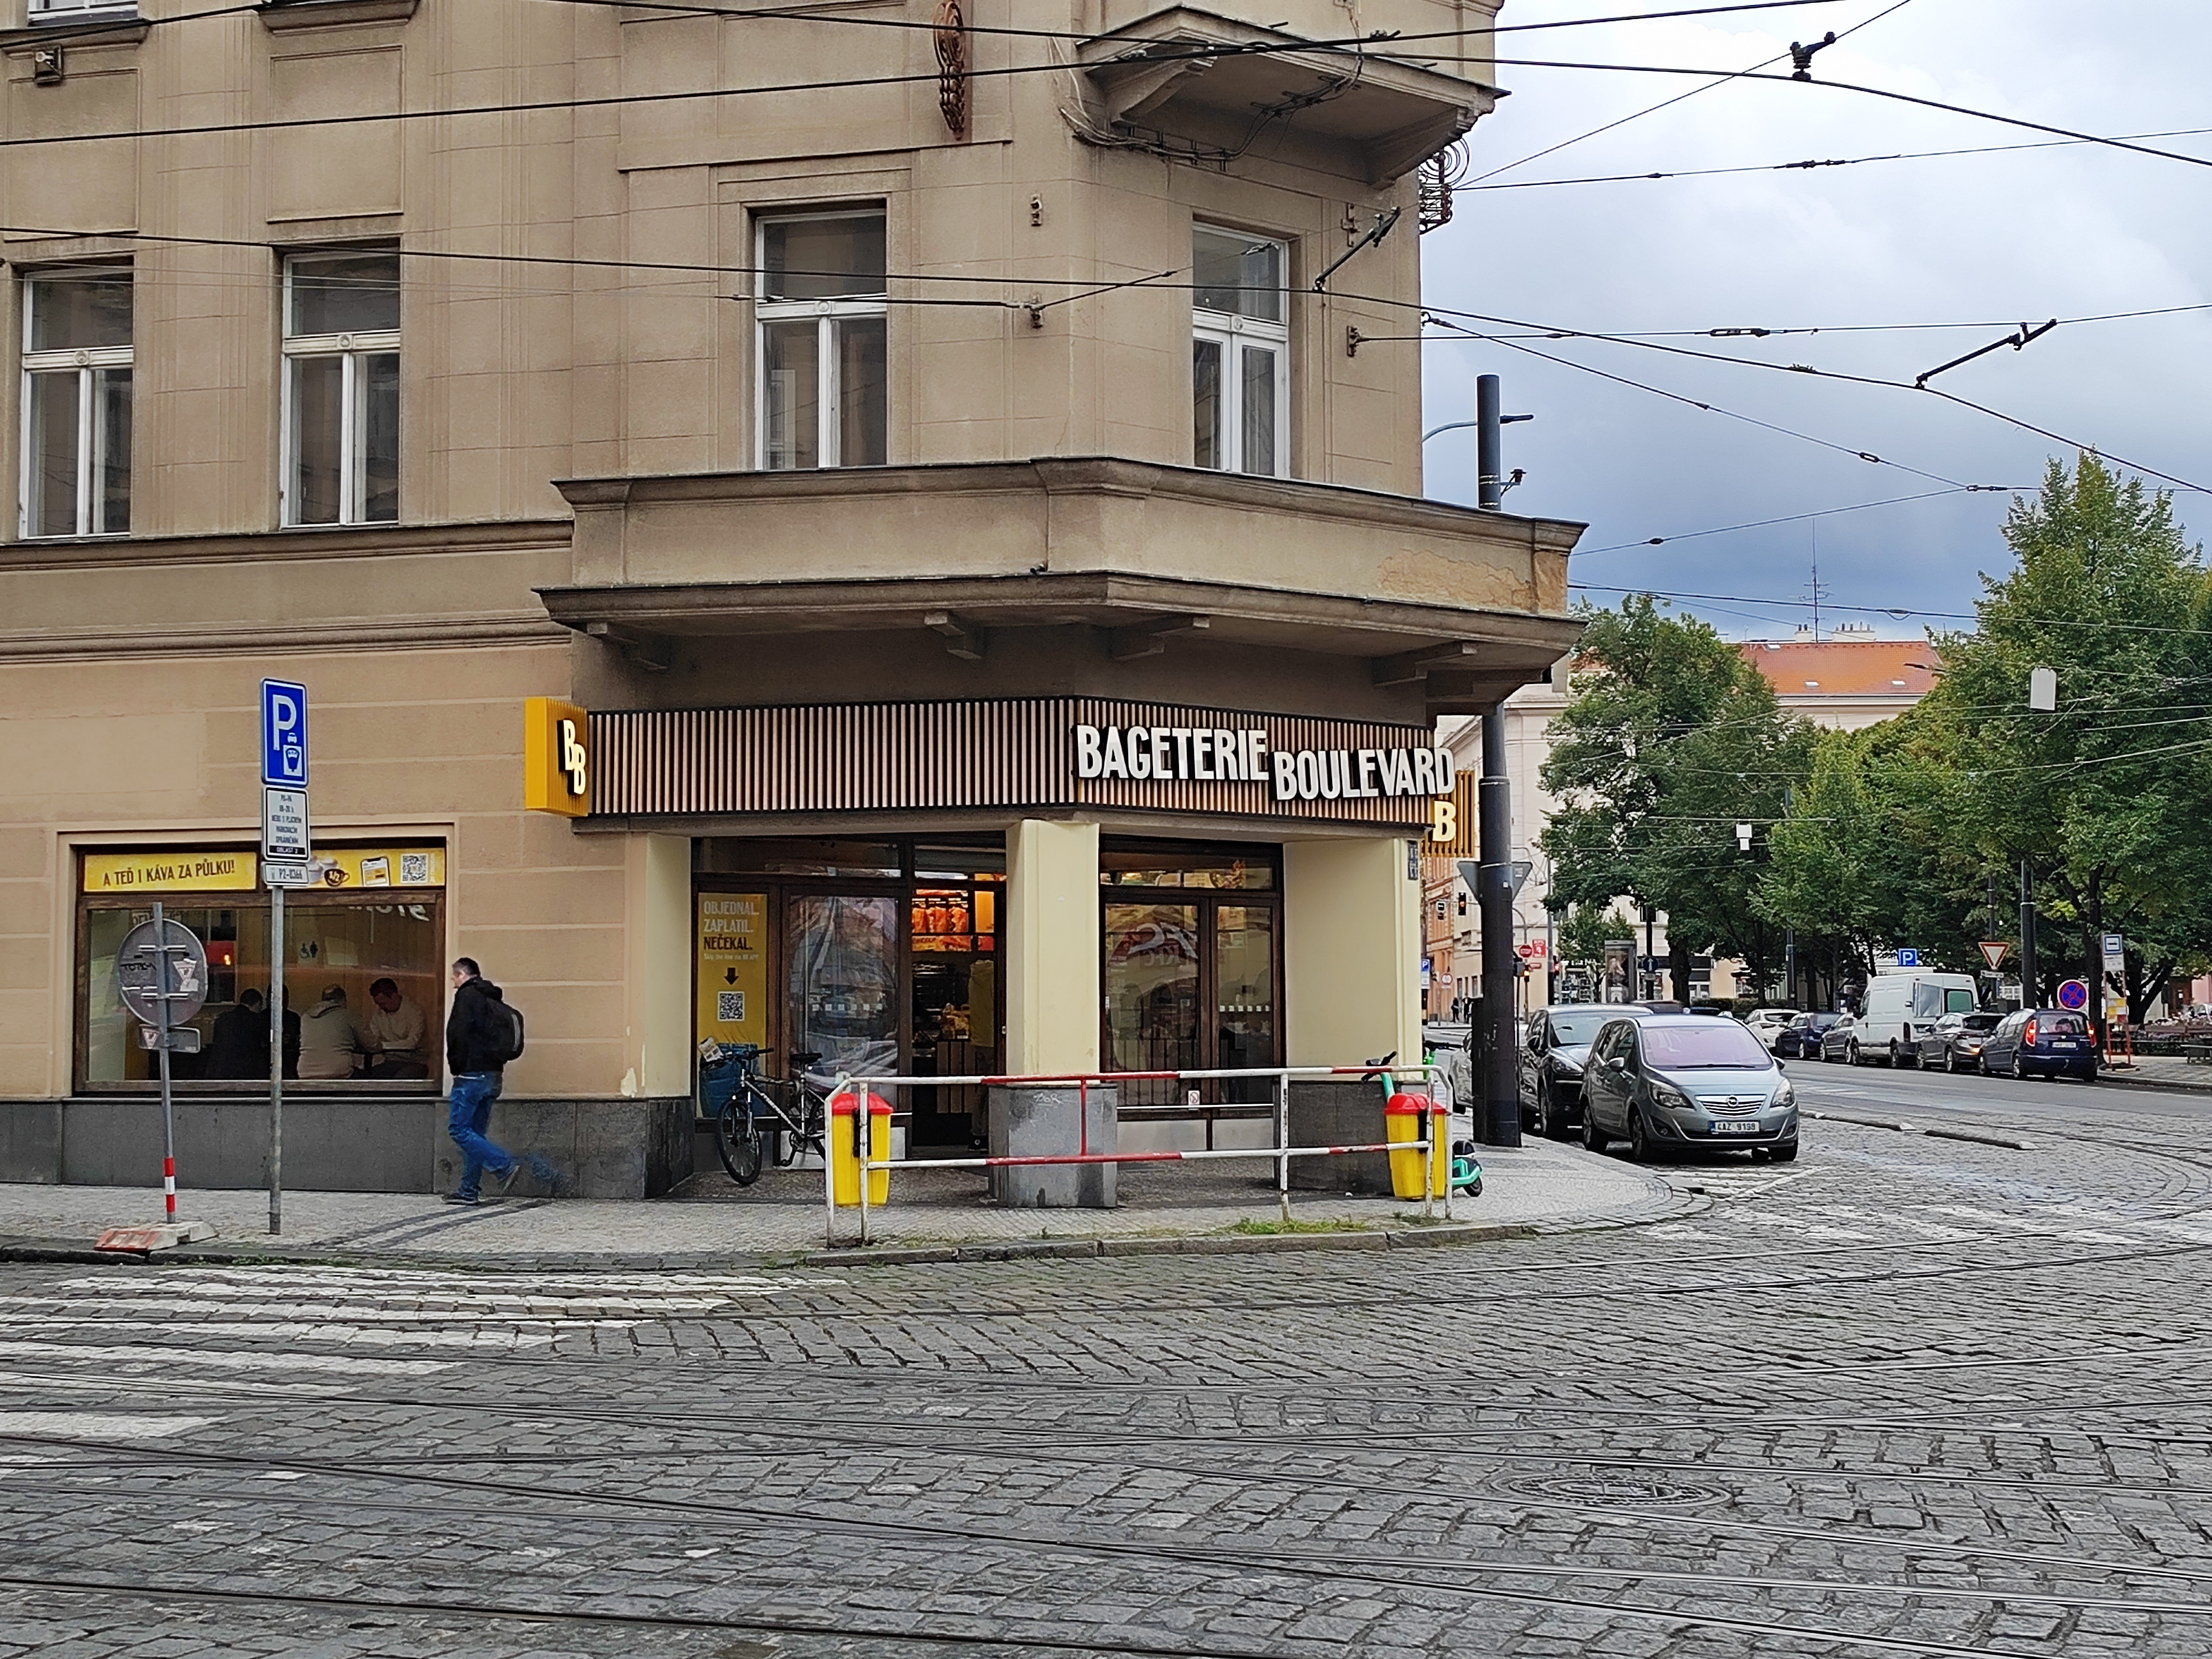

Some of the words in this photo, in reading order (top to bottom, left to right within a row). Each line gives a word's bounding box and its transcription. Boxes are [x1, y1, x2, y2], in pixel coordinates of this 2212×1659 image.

[273, 694, 297, 751] P
[563, 719, 586, 795] BB
[1077, 724, 1269, 780] BAGETERIE
[1274, 748, 1457, 800] BOULEVARD
[103, 872, 111, 886] A
[114, 867, 134, 885] TEĎ
[147, 864, 175, 882] KÁVA
[178, 864, 192, 879] ZA
[195, 858, 235, 877] PŮLKU!
[704, 901, 759, 915] OBJEDNAL.
[703, 919, 753, 932] ZAPLATIL.
[704, 933, 753, 950] NEČEKAL.
[1902, 952, 1913, 965] P
